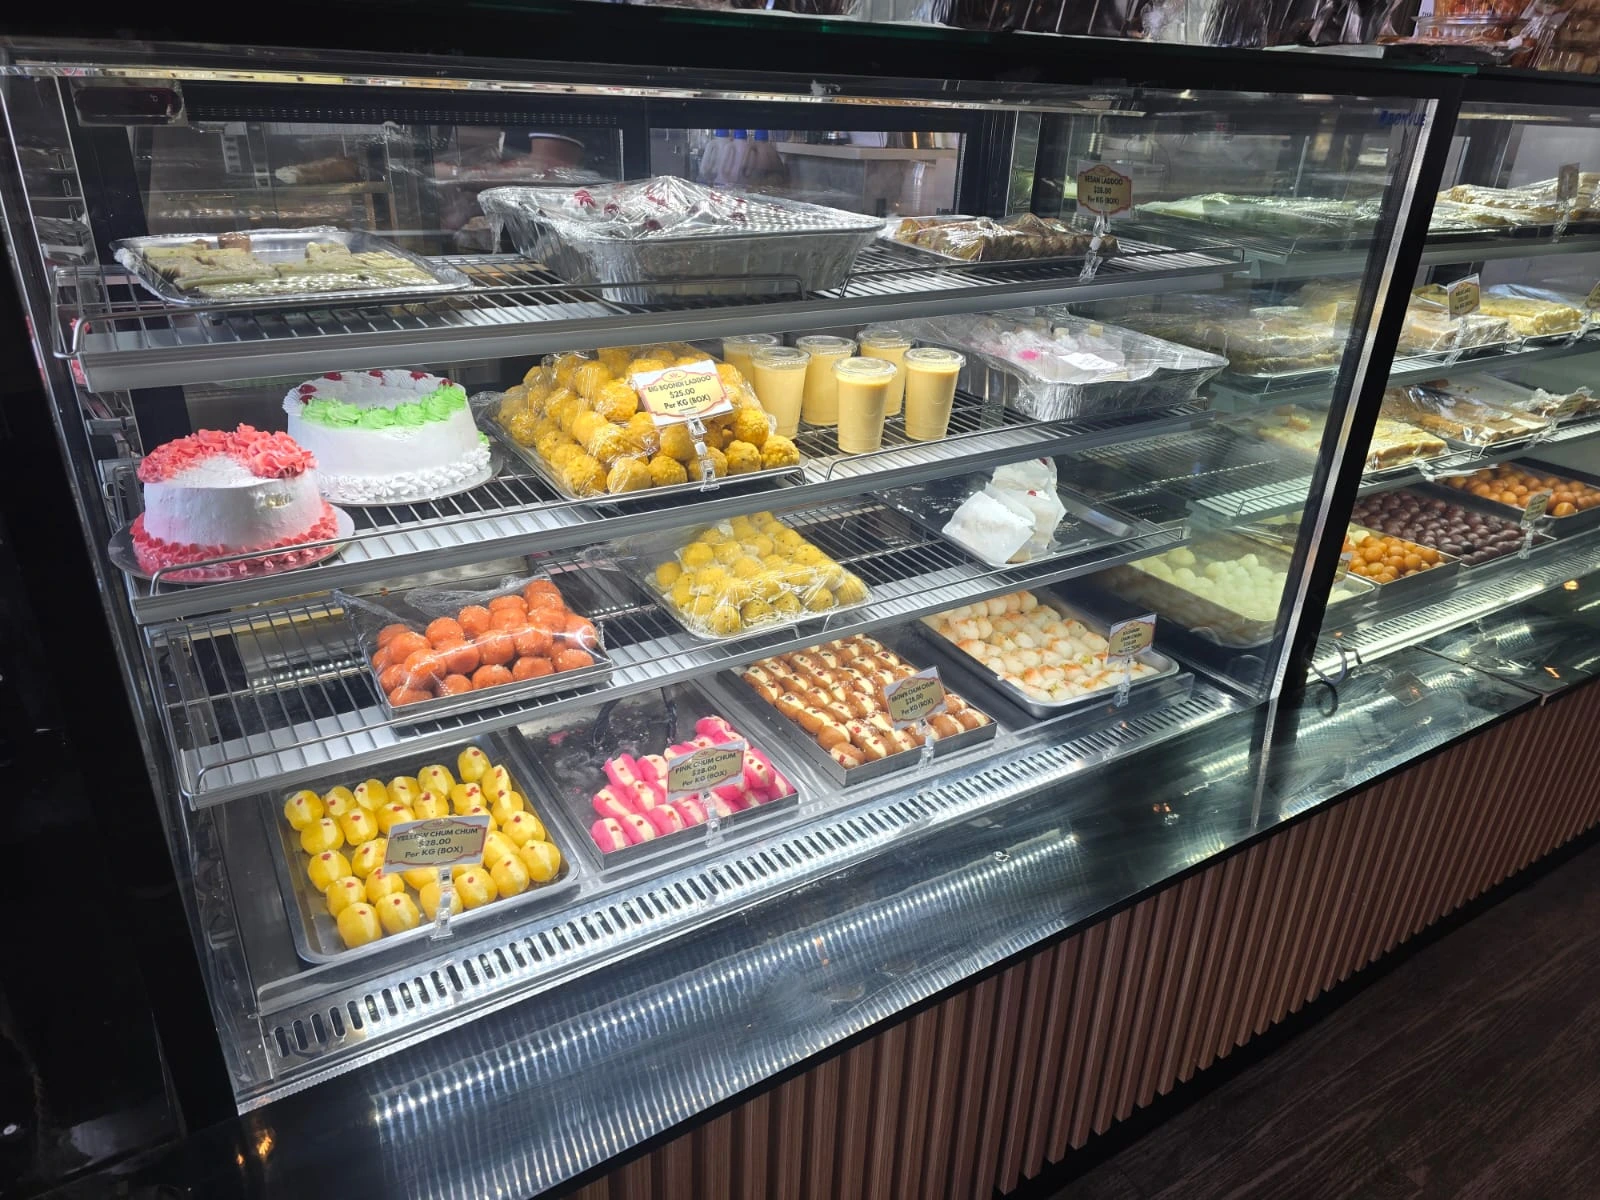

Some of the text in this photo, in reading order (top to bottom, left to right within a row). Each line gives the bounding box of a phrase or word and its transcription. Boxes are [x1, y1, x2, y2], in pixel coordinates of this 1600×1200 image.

[1101, 176, 1123, 185] LADDOO
[659, 381, 684, 391] BOONDI
[685, 375, 711, 385] LADDOO
[669, 388, 695, 399] $25.00
[677, 398, 688, 406] KG
[689, 394, 711, 405] (BOX)
[891, 681, 935, 702] BROWN CHUM CHUM
[910, 705, 918, 713] KG
[918, 698, 934, 708] (BOX)
[675, 752, 737, 774] PINK CHUM CHUM
[692, 765, 717, 776] $28.00
[682, 770, 727, 788] Per KG (BOX)
[430, 829, 454, 838] CHUM
[454, 828, 478, 836] CHUM
[419, 838, 451, 848] $28.00
[421, 848, 435, 856] KG
[437, 846, 463, 856] (BOX)
